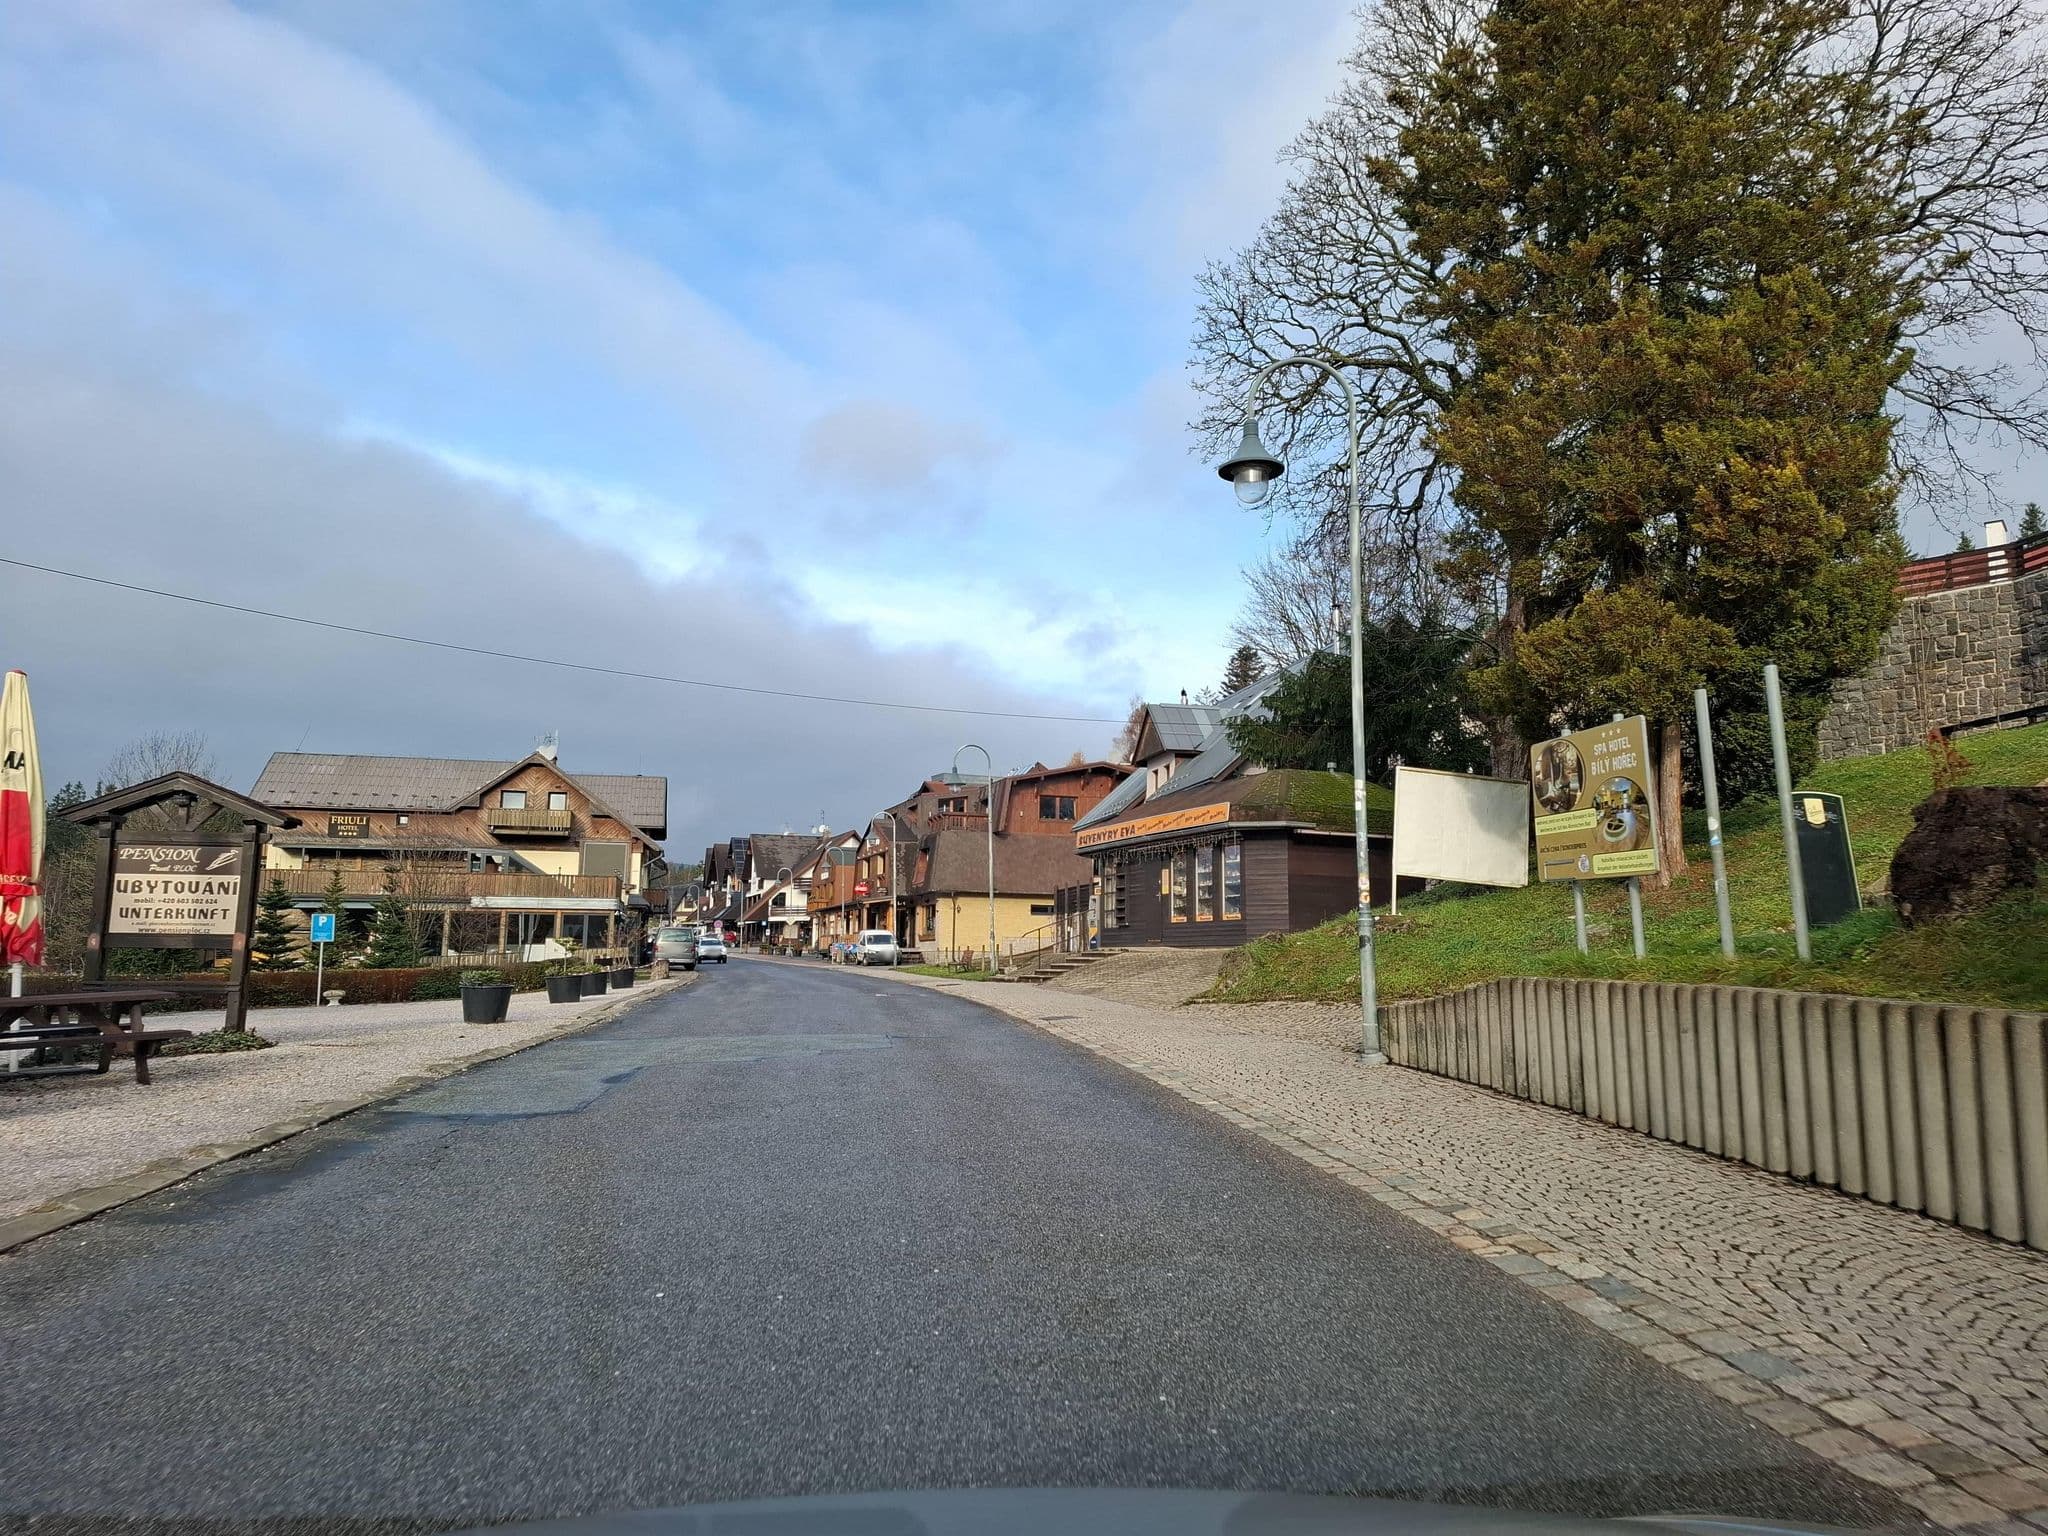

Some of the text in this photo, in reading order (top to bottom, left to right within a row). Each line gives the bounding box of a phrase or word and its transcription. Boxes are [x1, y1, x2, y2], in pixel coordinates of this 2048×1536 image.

[1609, 736, 1631, 752] HOTEL
[332, 816, 367, 824] FRIULI
[120, 847, 202, 863] PENSION
[120, 907, 230, 920] UNTERKUNFT
[318, 916, 328, 927] P
